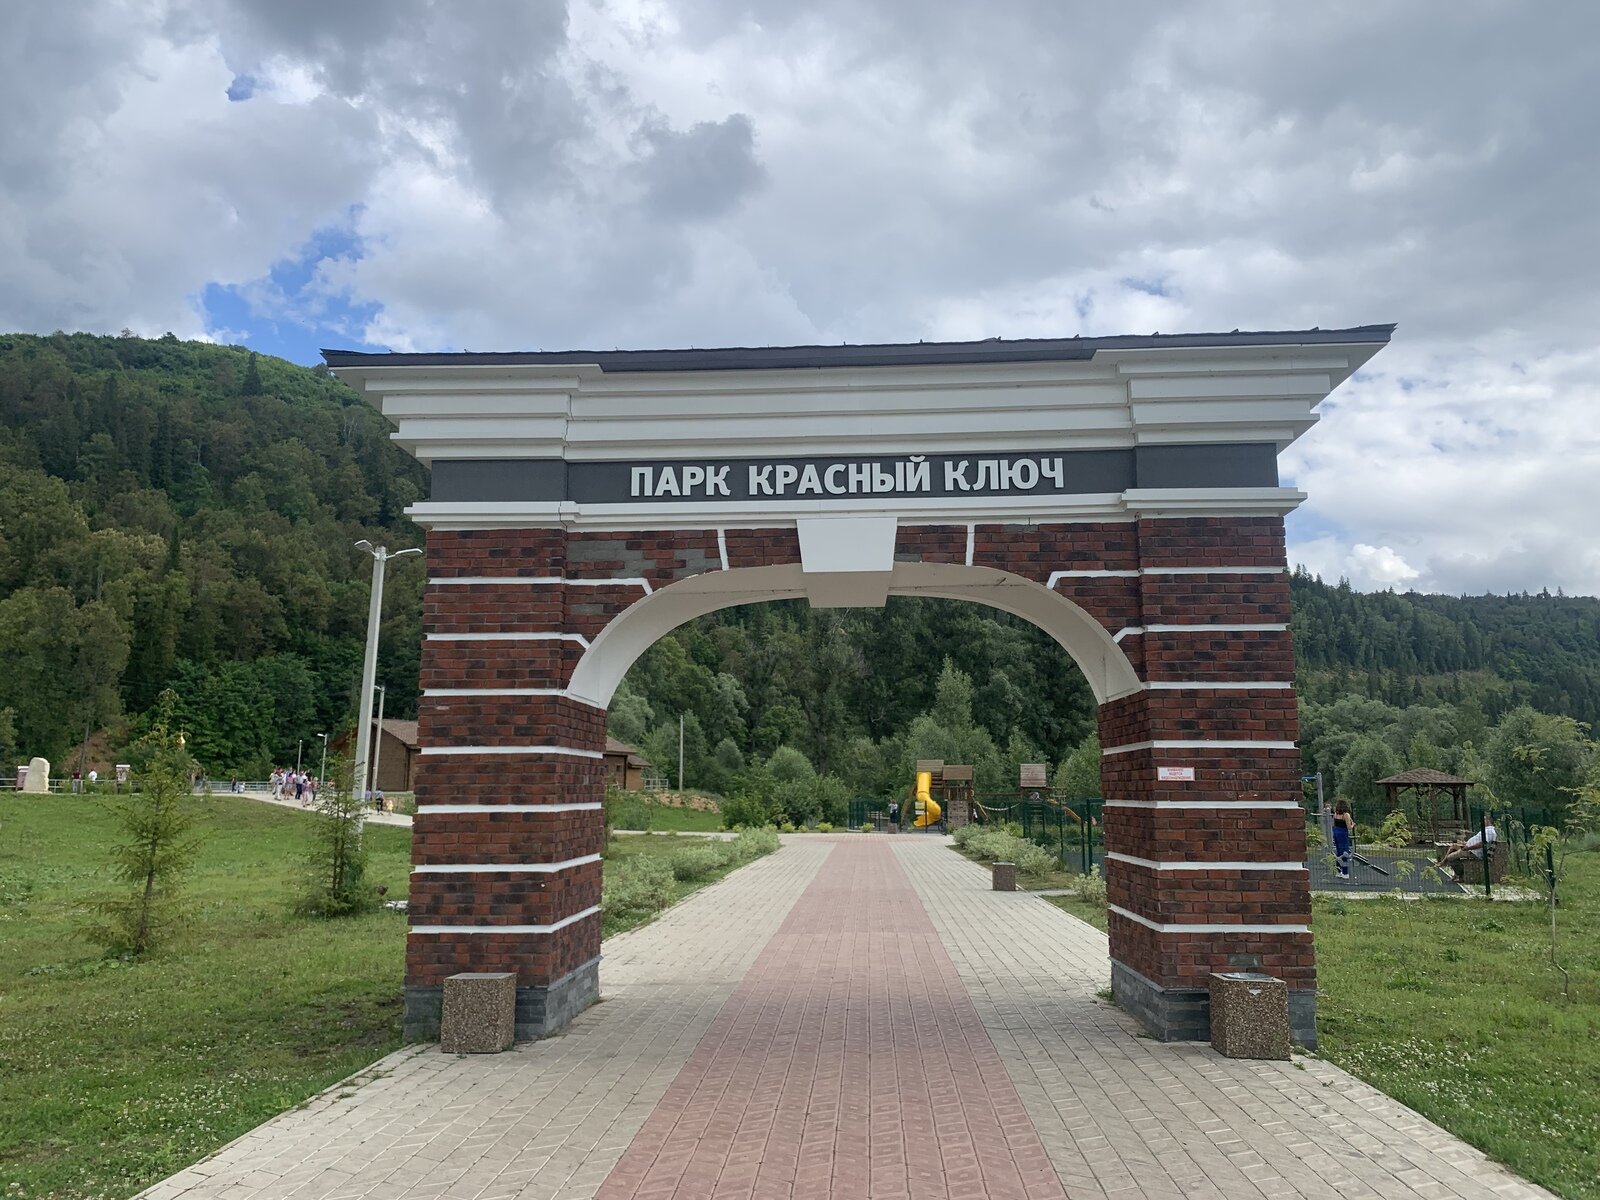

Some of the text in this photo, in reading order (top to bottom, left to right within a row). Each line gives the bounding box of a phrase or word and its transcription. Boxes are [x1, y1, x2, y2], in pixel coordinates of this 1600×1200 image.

[630, 455, 1065, 497] ПАРК КРАСНЫЙ КЛЮЧ
